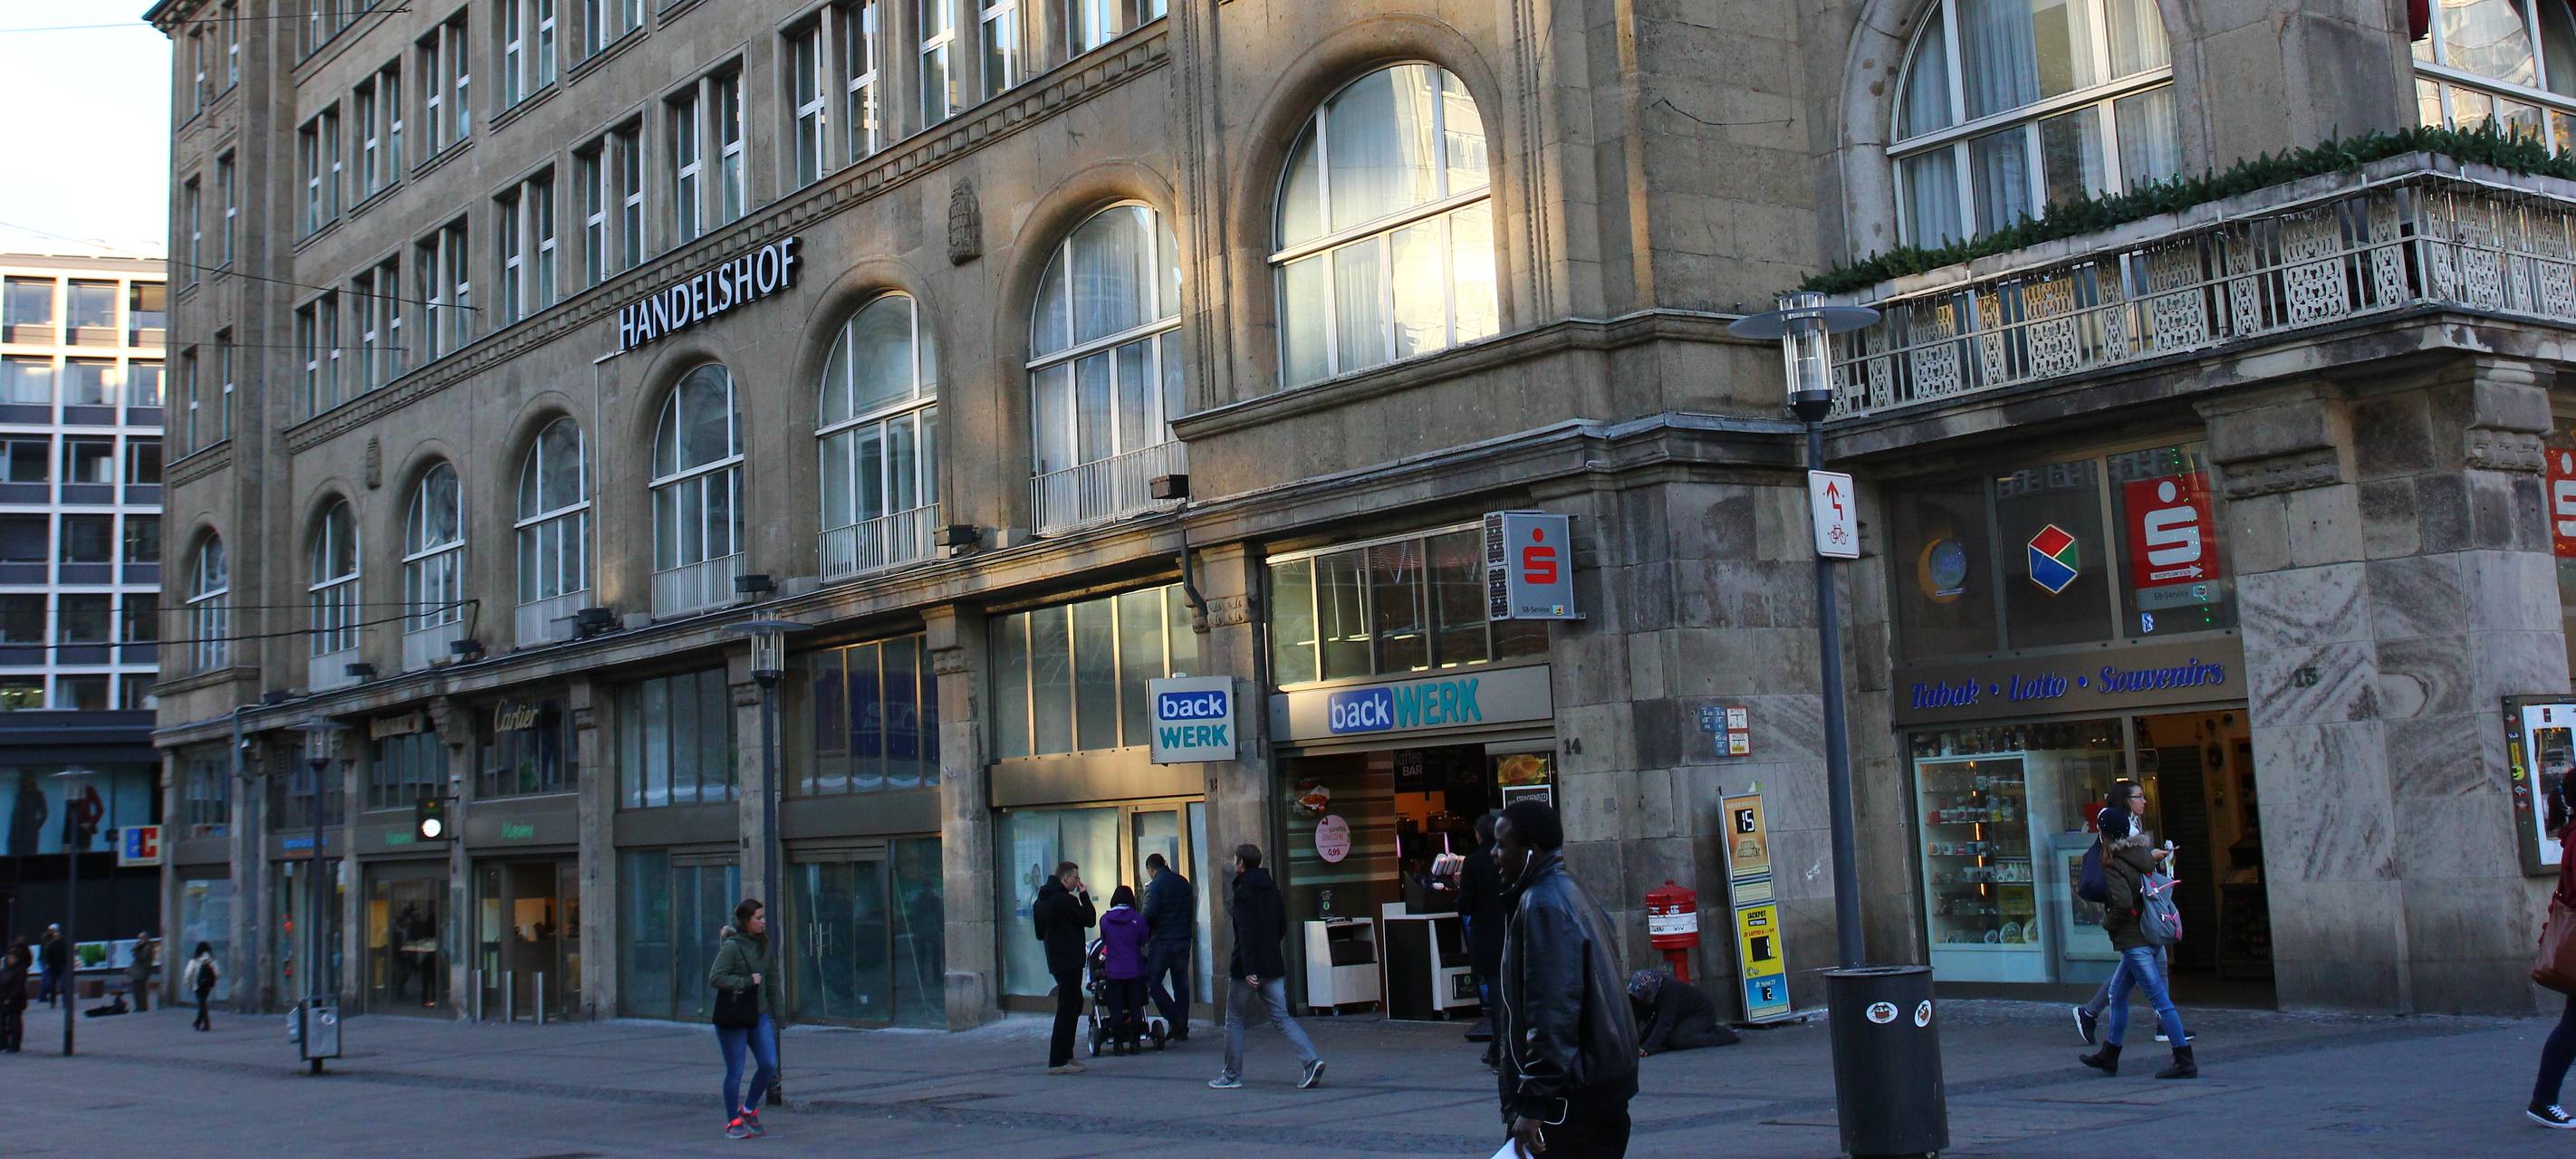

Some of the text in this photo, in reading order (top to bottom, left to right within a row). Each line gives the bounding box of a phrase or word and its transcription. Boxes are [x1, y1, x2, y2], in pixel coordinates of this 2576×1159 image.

[619, 236, 796, 350] HANDELSHOF
[2153, 590, 2188, 600] SB-Service
[1522, 606, 1550, 614] SB-Service
[1911, 657, 2225, 709] Tabak Lotto Souvenirs
[2294, 666, 2318, 687] 15
[493, 698, 539, 733] Cartier
[1162, 694, 1225, 717] back
[1159, 723, 1228, 750] WERK
[1564, 737, 1581, 755] 14
[1402, 764, 1423, 776] BAR
[1741, 809, 1755, 832] 15
[1747, 910, 1766, 919] JACKPOT
